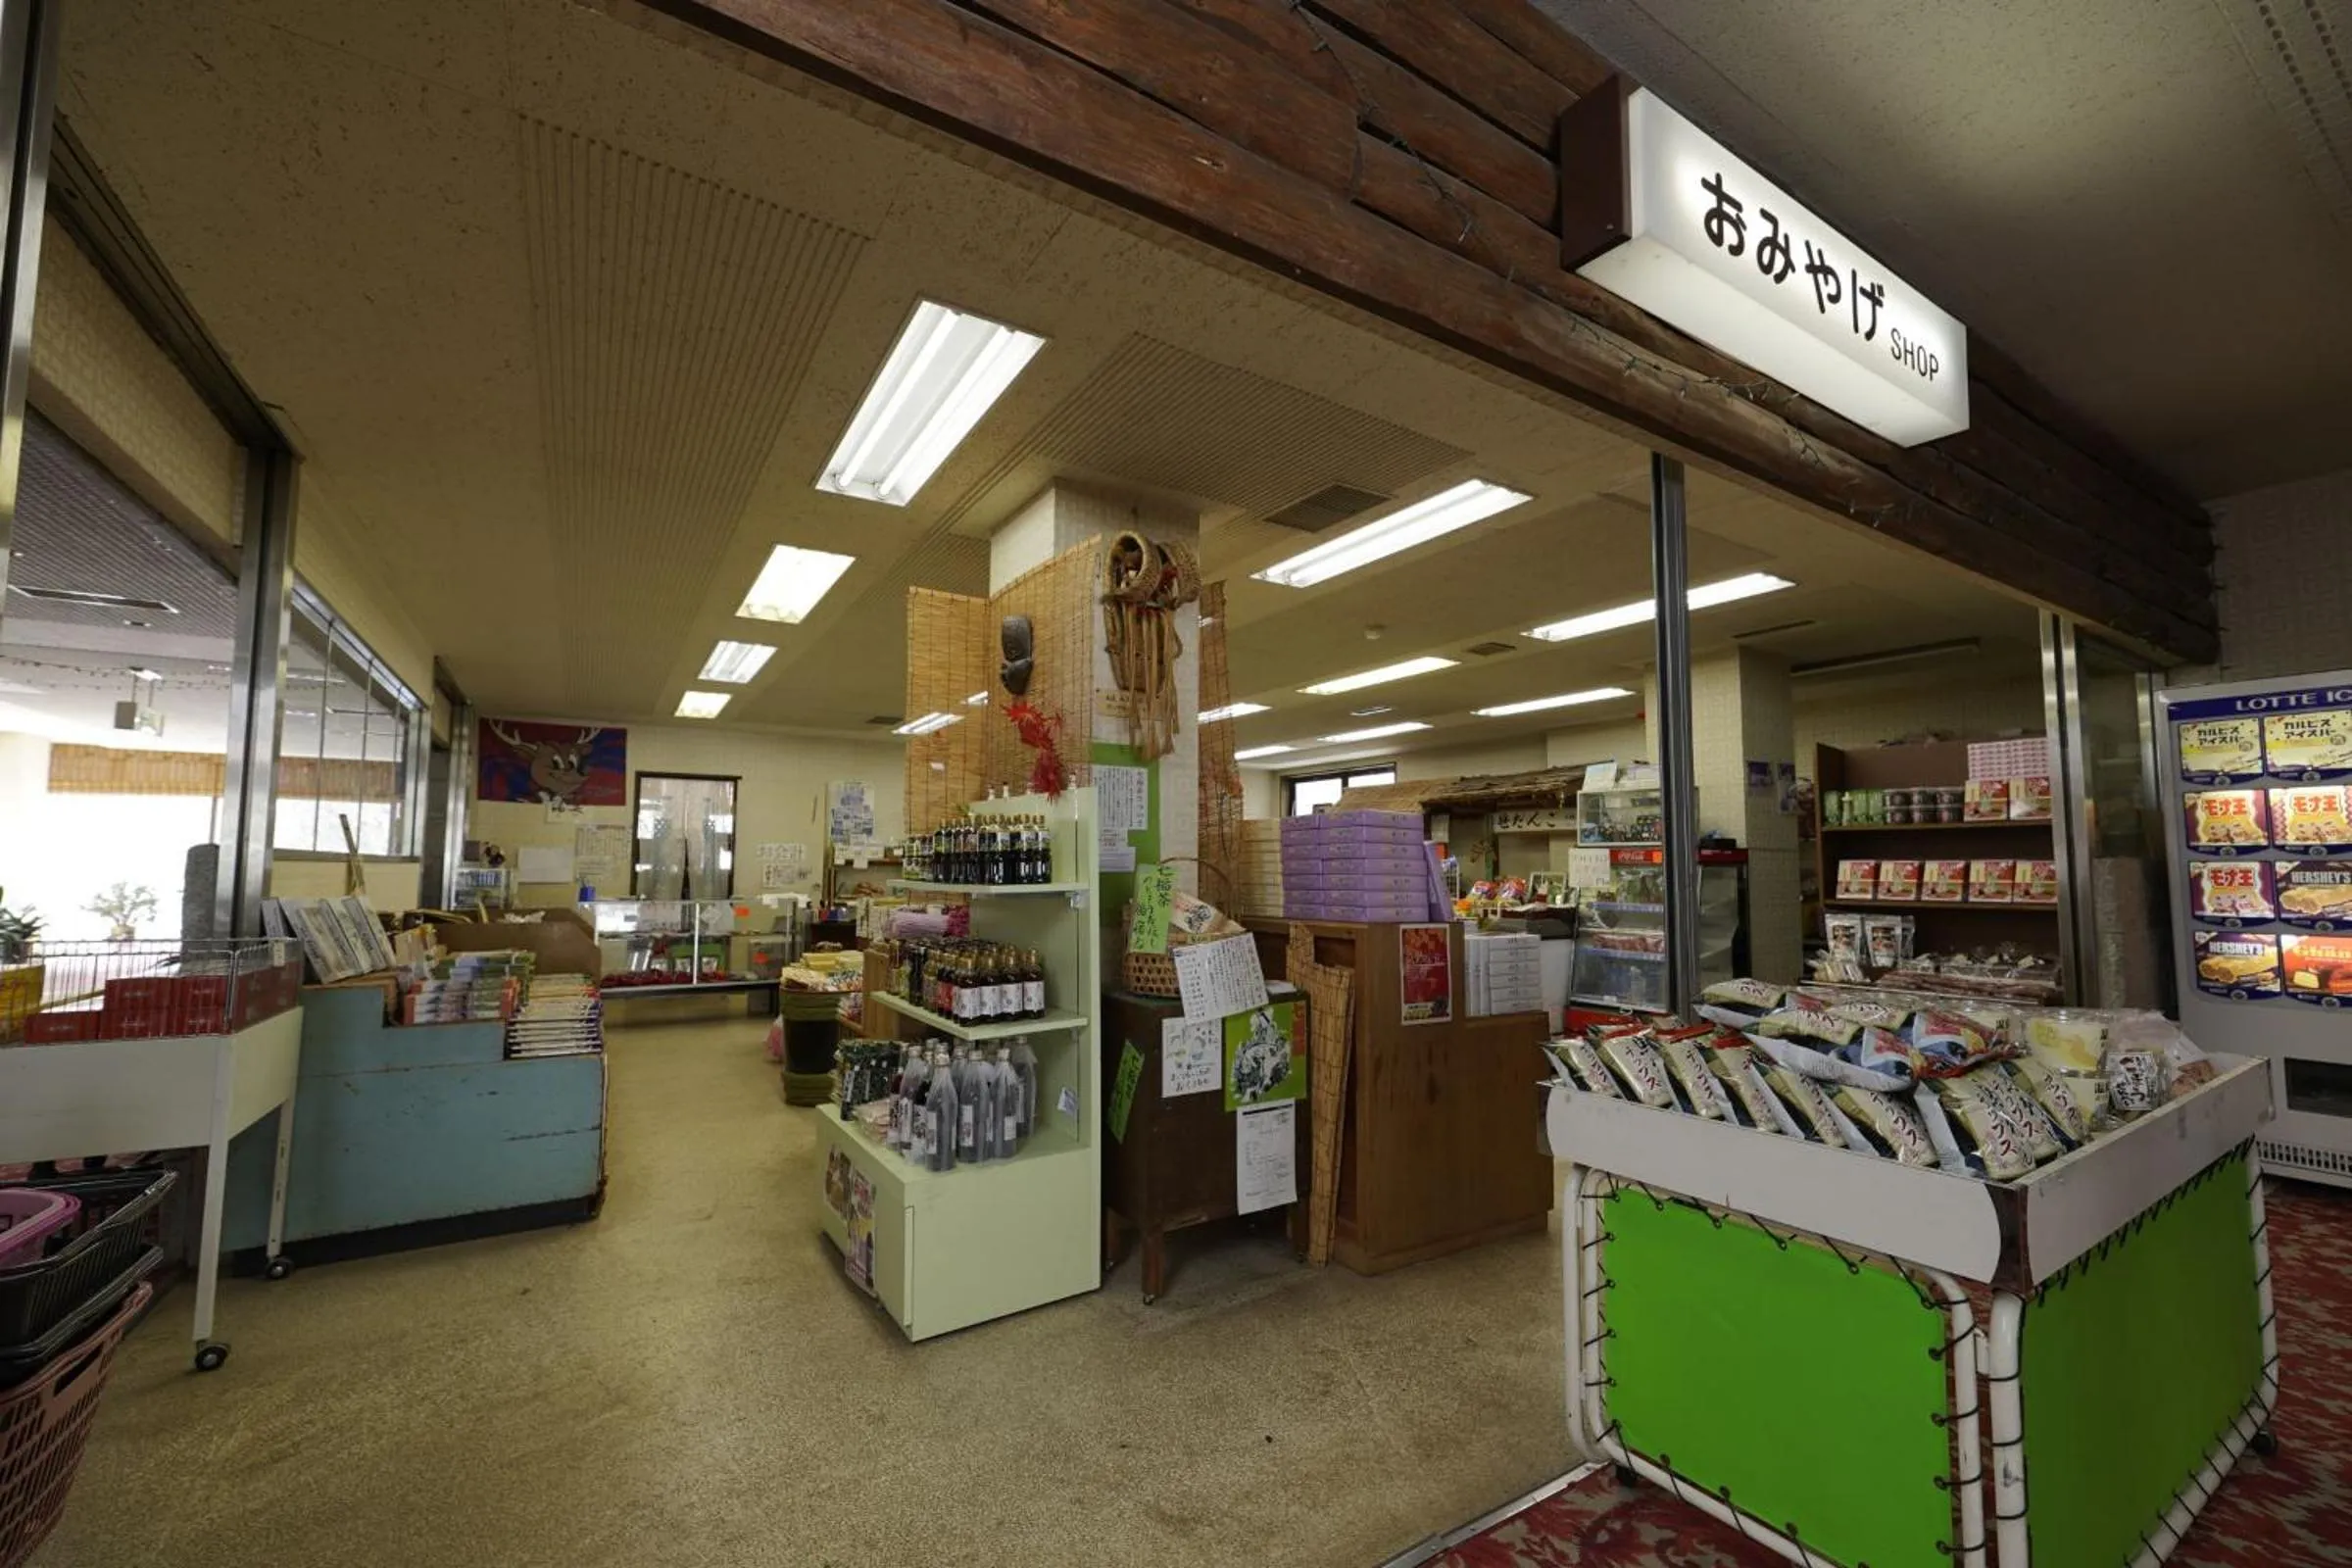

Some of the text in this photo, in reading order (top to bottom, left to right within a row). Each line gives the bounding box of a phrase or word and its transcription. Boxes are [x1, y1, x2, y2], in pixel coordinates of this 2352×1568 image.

[1700, 172, 1939, 381] おみやげ SHOP
[2235, 692, 2318, 711] LOTTE
[2205, 798, 2247, 816] モナ王
[2293, 795, 2339, 812] モナ王
[2210, 868, 2254, 887] モナ王
[2290, 870, 2351, 884] HERSHEY'S
